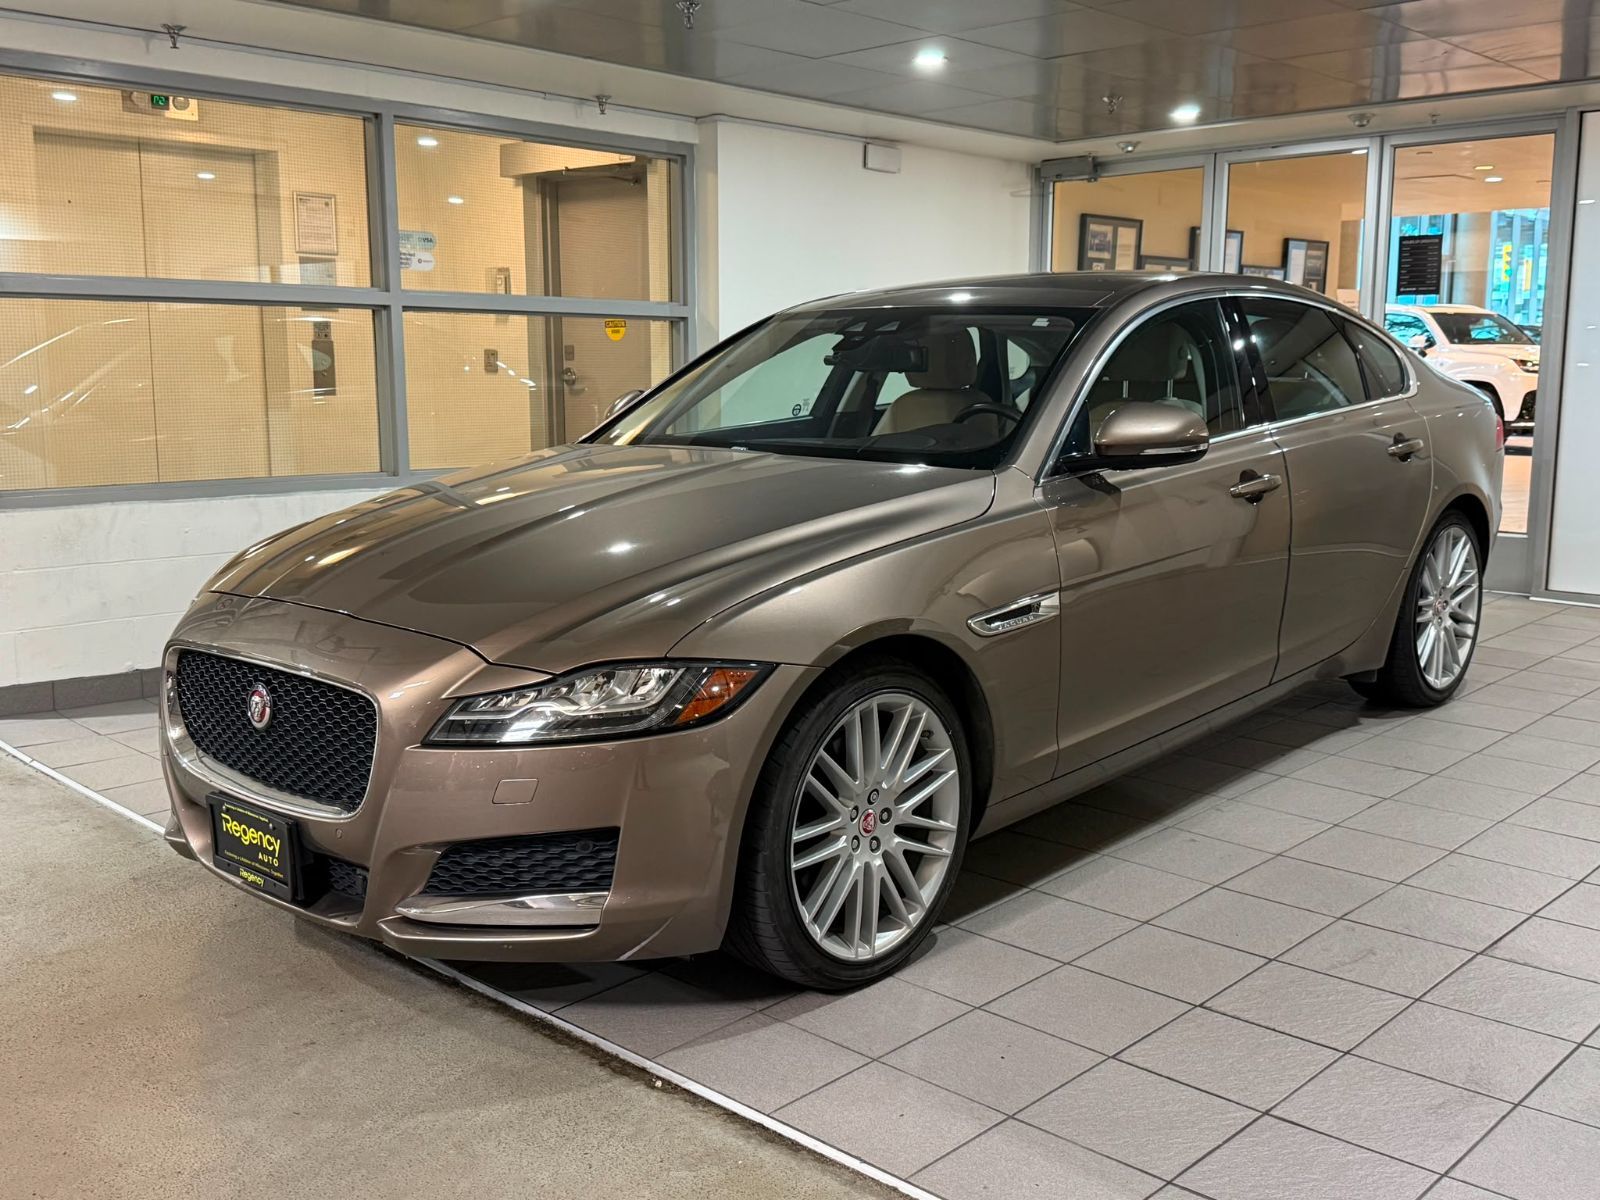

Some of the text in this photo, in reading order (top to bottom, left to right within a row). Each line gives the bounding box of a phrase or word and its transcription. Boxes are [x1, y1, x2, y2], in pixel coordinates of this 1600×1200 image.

[999, 614, 1035, 630] JAGUAR
[221, 813, 280, 857] Regency
[258, 852, 279, 867] AUTO
[240, 868, 264, 887] Regency
